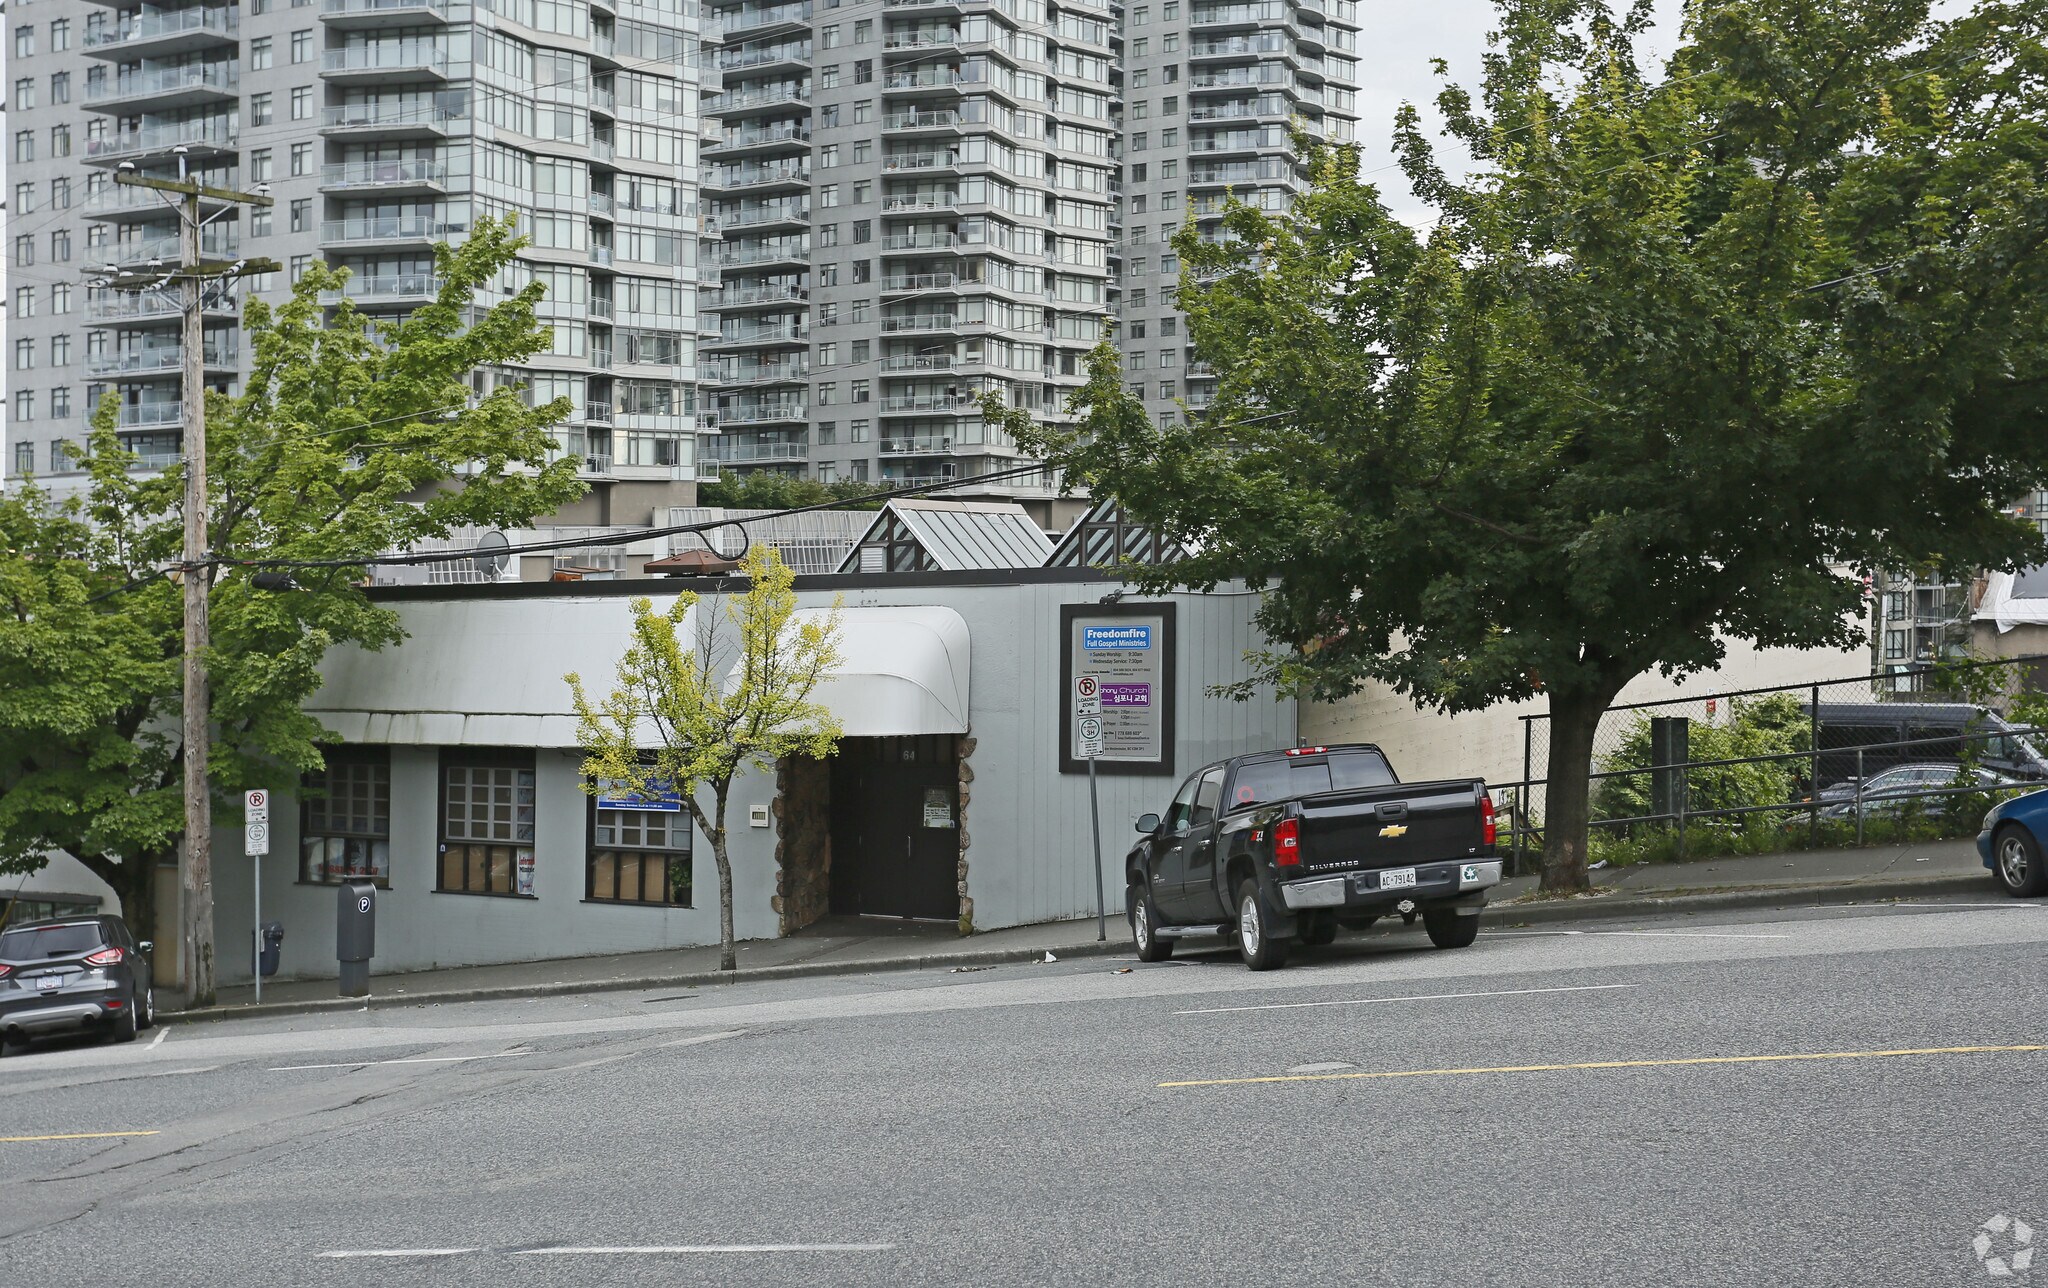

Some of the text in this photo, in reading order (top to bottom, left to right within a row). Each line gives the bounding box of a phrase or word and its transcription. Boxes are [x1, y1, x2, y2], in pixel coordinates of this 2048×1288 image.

[1087, 629, 1146, 638] Freedomfire
[1098, 640, 1118, 648] Gospel
[1114, 695, 1147, 703] 심포니 교회
[903, 750, 915, 760] 64
[1309, 860, 1359, 871] SILVERADO
